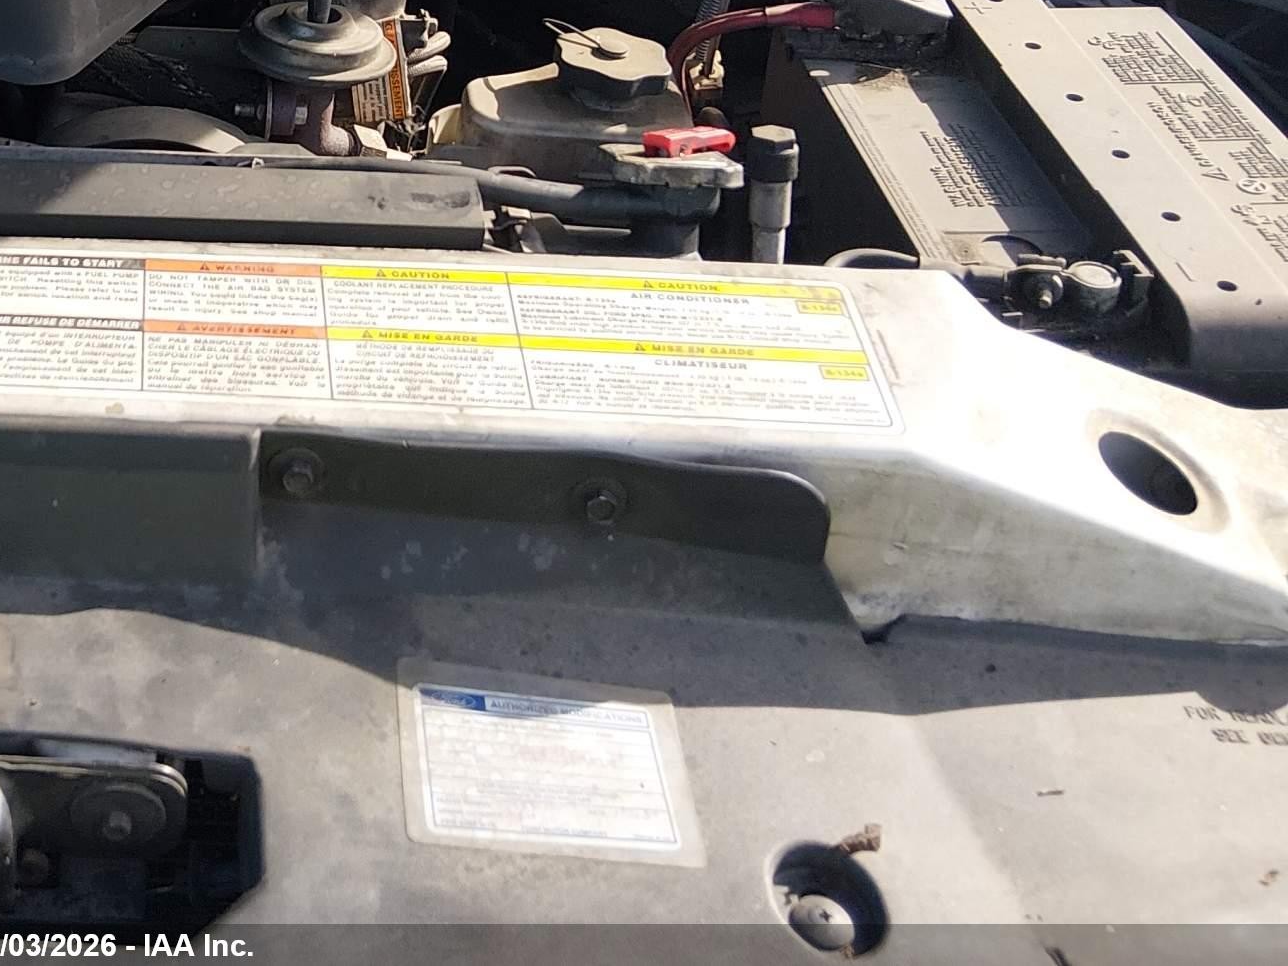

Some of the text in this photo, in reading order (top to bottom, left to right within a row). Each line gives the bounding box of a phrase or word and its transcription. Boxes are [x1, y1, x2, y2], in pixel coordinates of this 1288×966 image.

[22, 256, 58, 265] FAILS
[82, 259, 123, 267] START
[657, 282, 717, 291] CAUTION
[657, 294, 749, 303] CONDITIONER
[11, 316, 57, 325] REFUSE
[58, 318, 75, 326] DE
[76, 319, 140, 328] DÉMARRER
[193, 325, 296, 334] AVERTISSEMENT
[434, 334, 478, 342] GARDE
[652, 344, 682, 352] MISE
[710, 347, 754, 355] GARDE
[654, 359, 747, 369] CLIMATISEUR
[490, 699, 558, 714] AUTHORIZED
[560, 706, 644, 724] MODIFICATIONS
